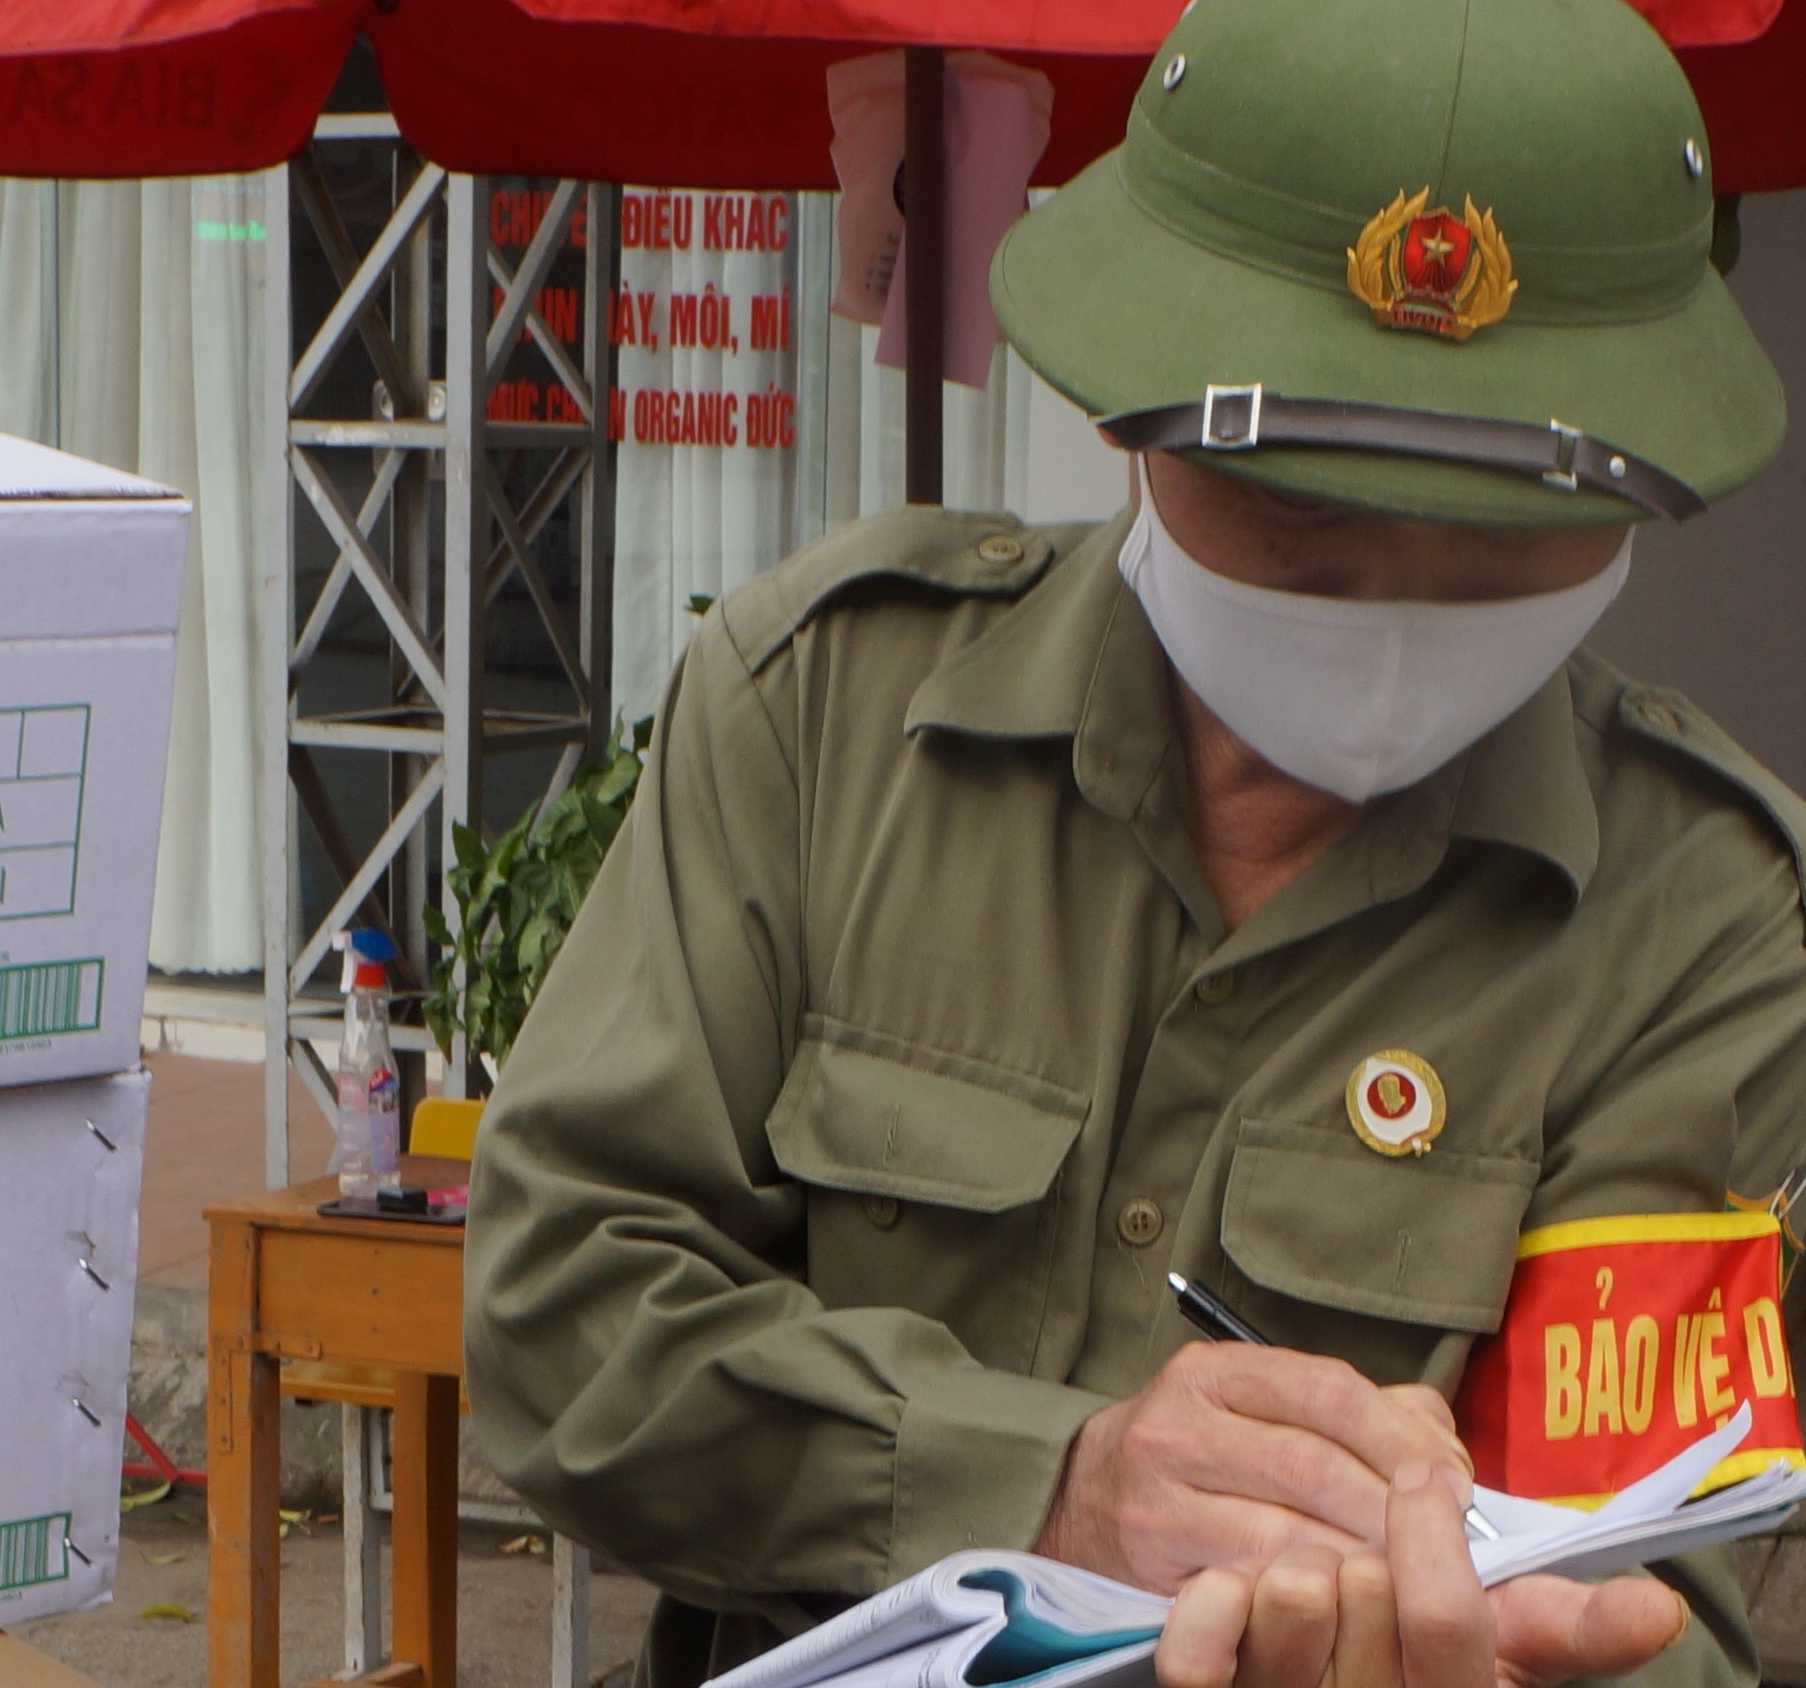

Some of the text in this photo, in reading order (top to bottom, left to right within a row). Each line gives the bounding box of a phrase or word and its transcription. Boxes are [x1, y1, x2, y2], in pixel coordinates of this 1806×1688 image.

[634, 389, 738, 446] ORGANIC
[1545, 1266, 1660, 1440] BẢO
[1673, 1286, 1736, 1431] VỆ
